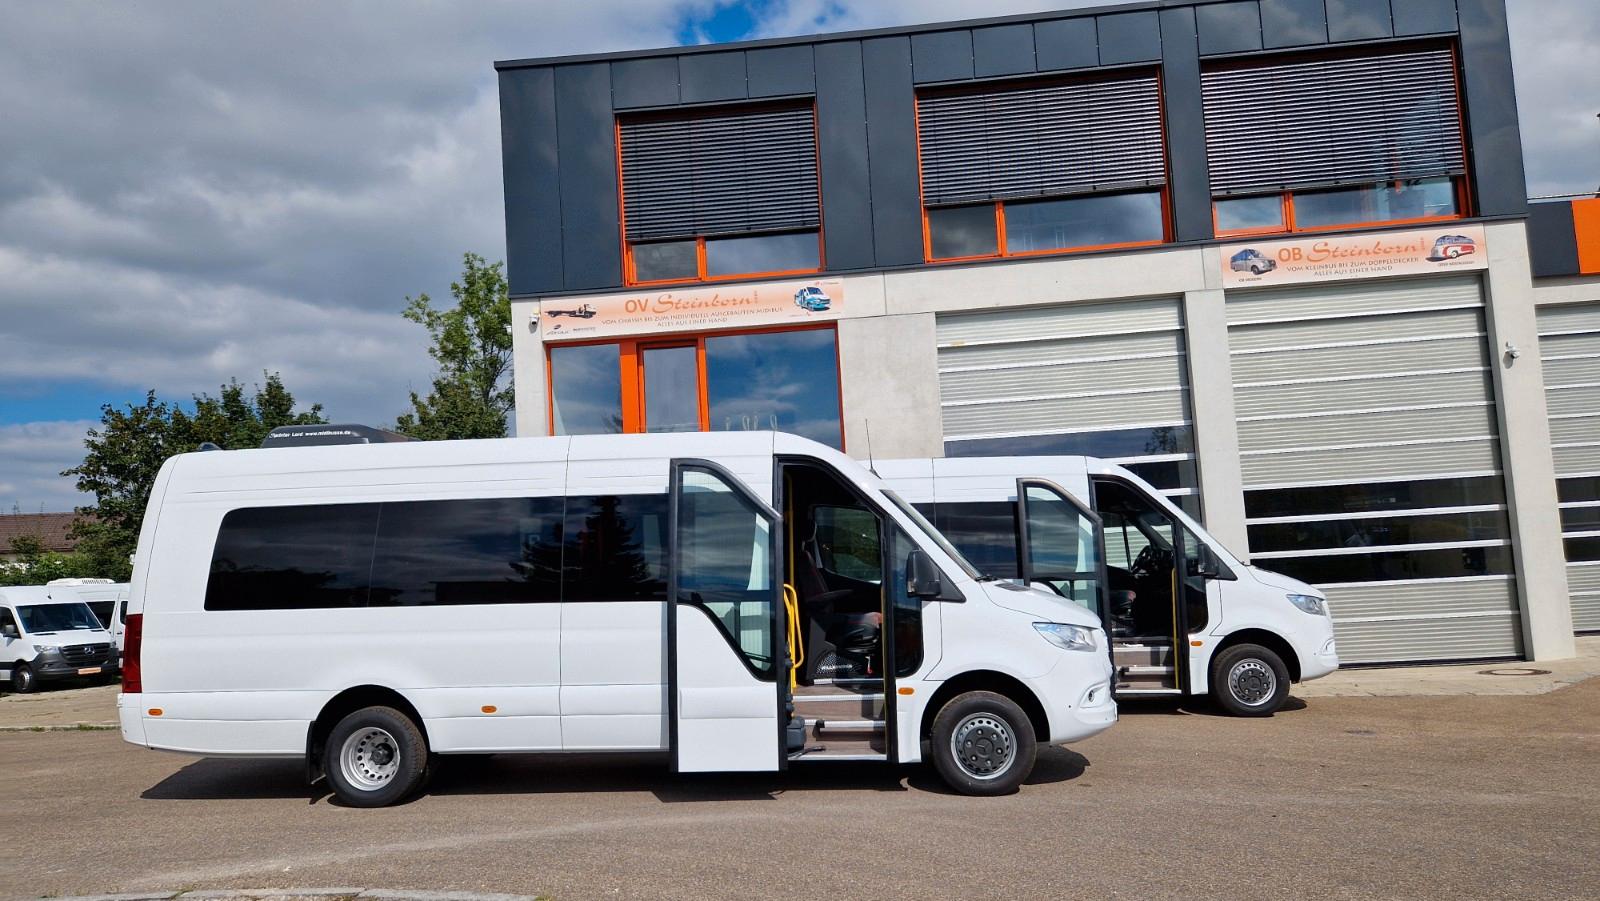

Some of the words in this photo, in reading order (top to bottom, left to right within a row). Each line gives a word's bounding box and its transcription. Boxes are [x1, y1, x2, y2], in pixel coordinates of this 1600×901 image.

[1278, 247, 1303, 262] OB
[1306, 241, 1417, 262] Steinborn
[1368, 257, 1419, 266] DOPPELDECKER
[624, 298, 649, 313] OV
[652, 293, 752, 313] Steinborn
